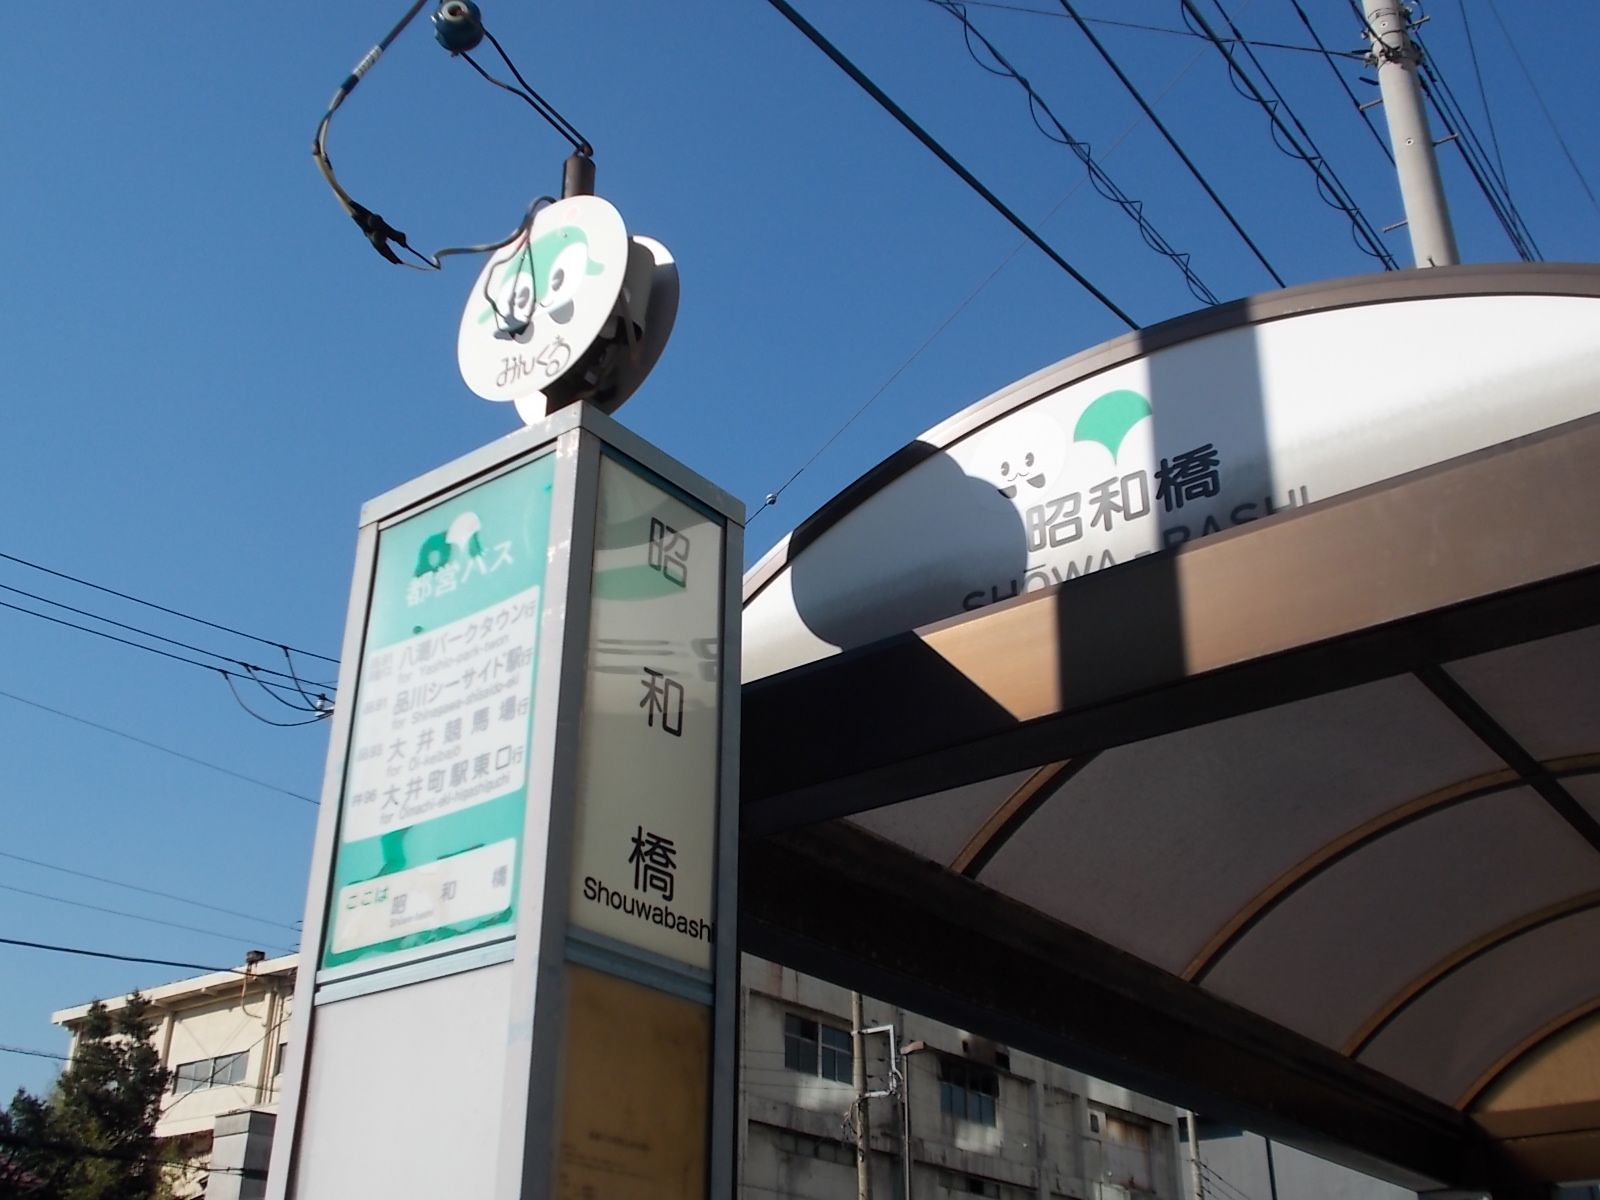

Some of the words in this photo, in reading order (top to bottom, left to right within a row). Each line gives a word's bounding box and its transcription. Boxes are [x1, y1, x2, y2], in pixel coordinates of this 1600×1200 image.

[1026, 443, 1221, 552] 昭和橋
[628, 516, 690, 902] 昭和橋
[381, 741, 524, 811] 大井町駅東口行
